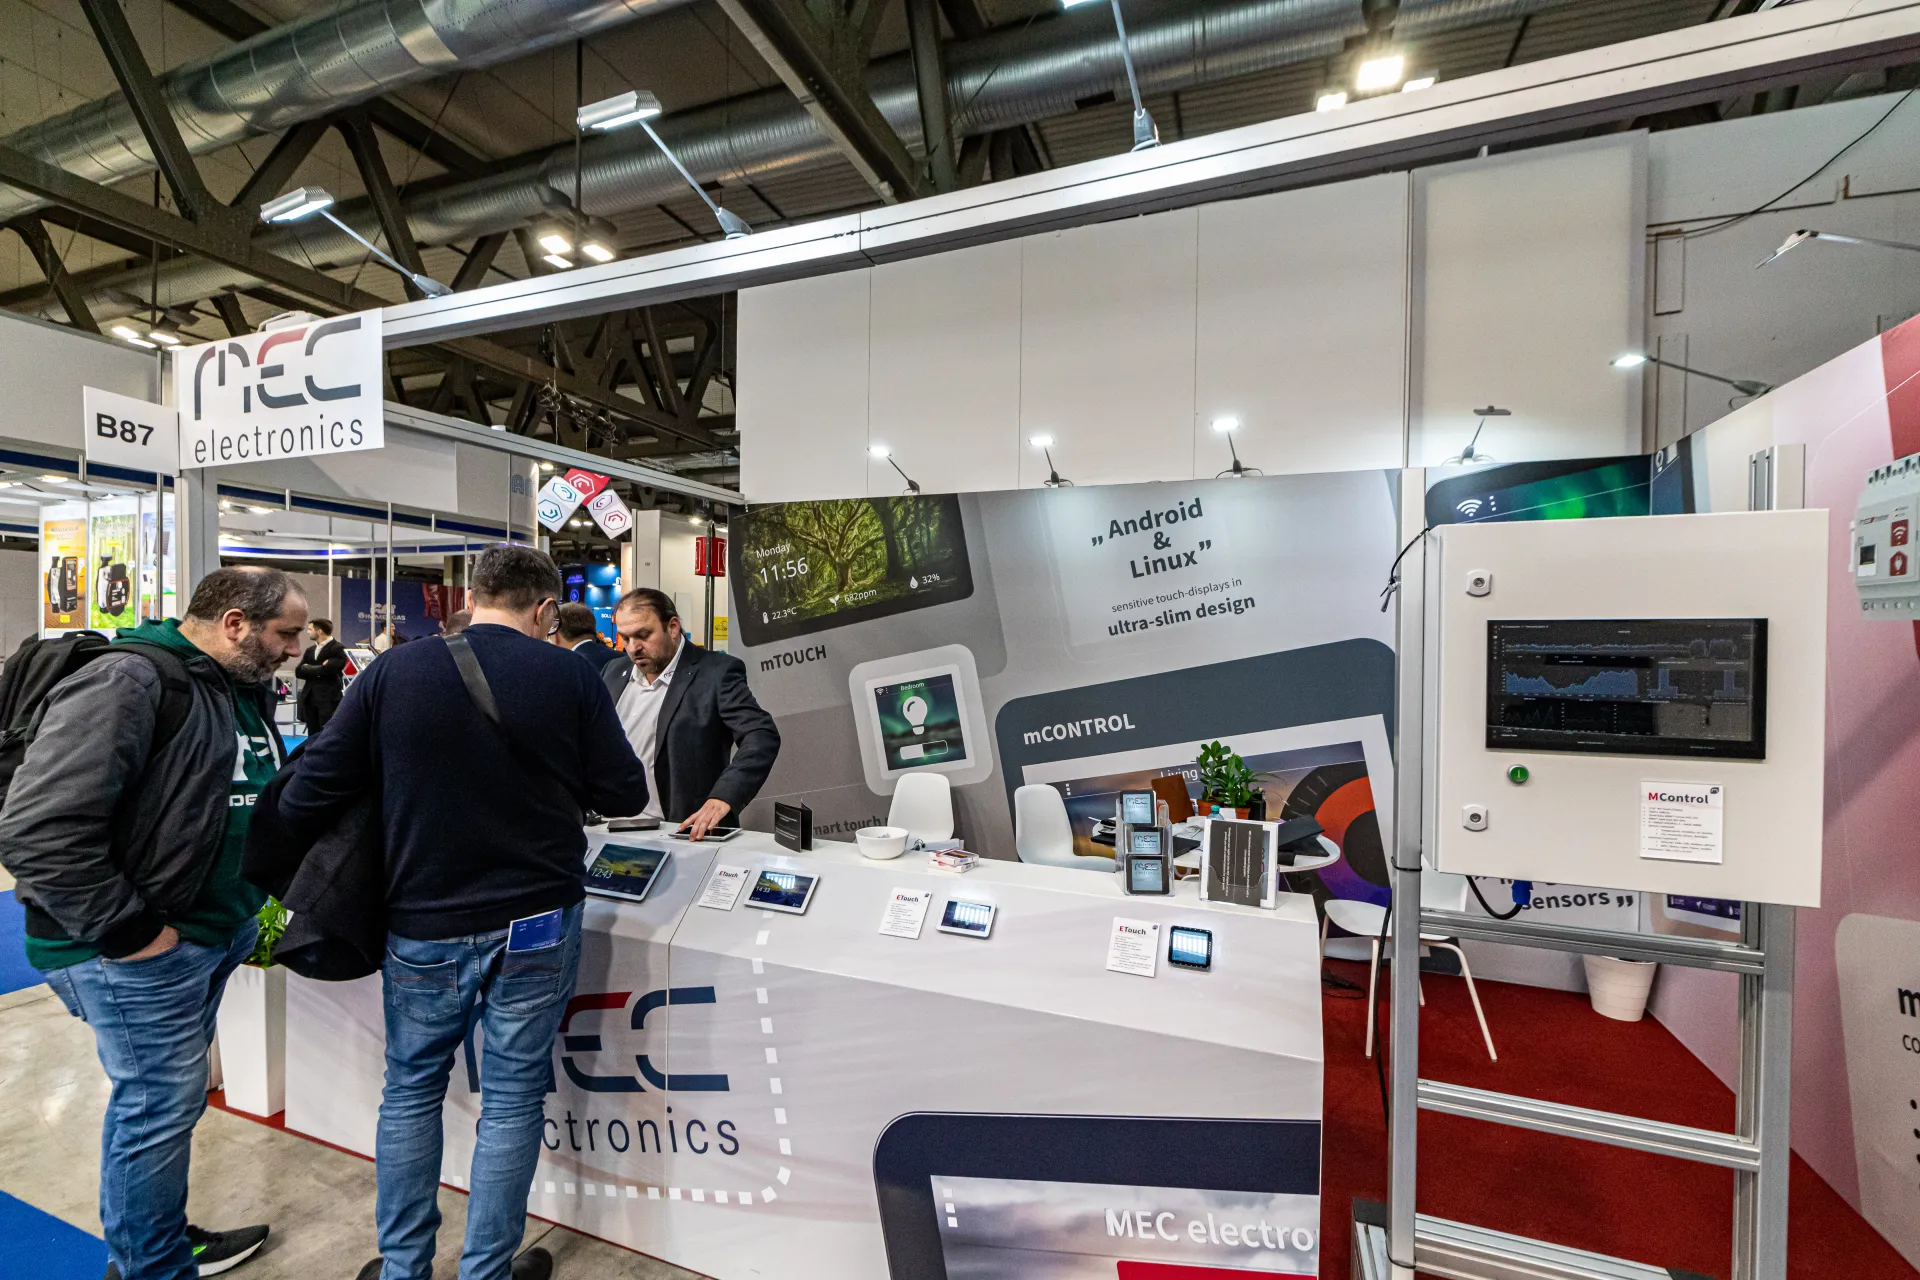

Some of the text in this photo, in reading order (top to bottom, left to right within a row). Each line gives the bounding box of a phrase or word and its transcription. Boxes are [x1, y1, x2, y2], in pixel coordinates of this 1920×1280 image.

[96, 412, 154, 447] B87
[194, 414, 363, 463] electronics
[756, 543, 791, 558] Monday
[1153, 531, 1172, 550] &
[760, 557, 809, 584] 11:56
[922, 573, 941, 584] 32%
[844, 589, 877, 603] 682ppm
[1111, 578, 1243, 613] sensitive touch-displays in
[1108, 596, 1256, 636] ultra-slim design
[760, 645, 827, 672] mTOUCH
[900, 682, 925, 691] Bedroom
[1023, 713, 1136, 745] mCONTROL
[1648, 792, 1709, 804] MControl
[813, 820, 842, 837] mart
[844, 815, 881, 833] touch
[896, 894, 919, 903] ETouch
[542, 1106, 740, 1155] ctronics
[1104, 1208, 1319, 1253] MEC electro
